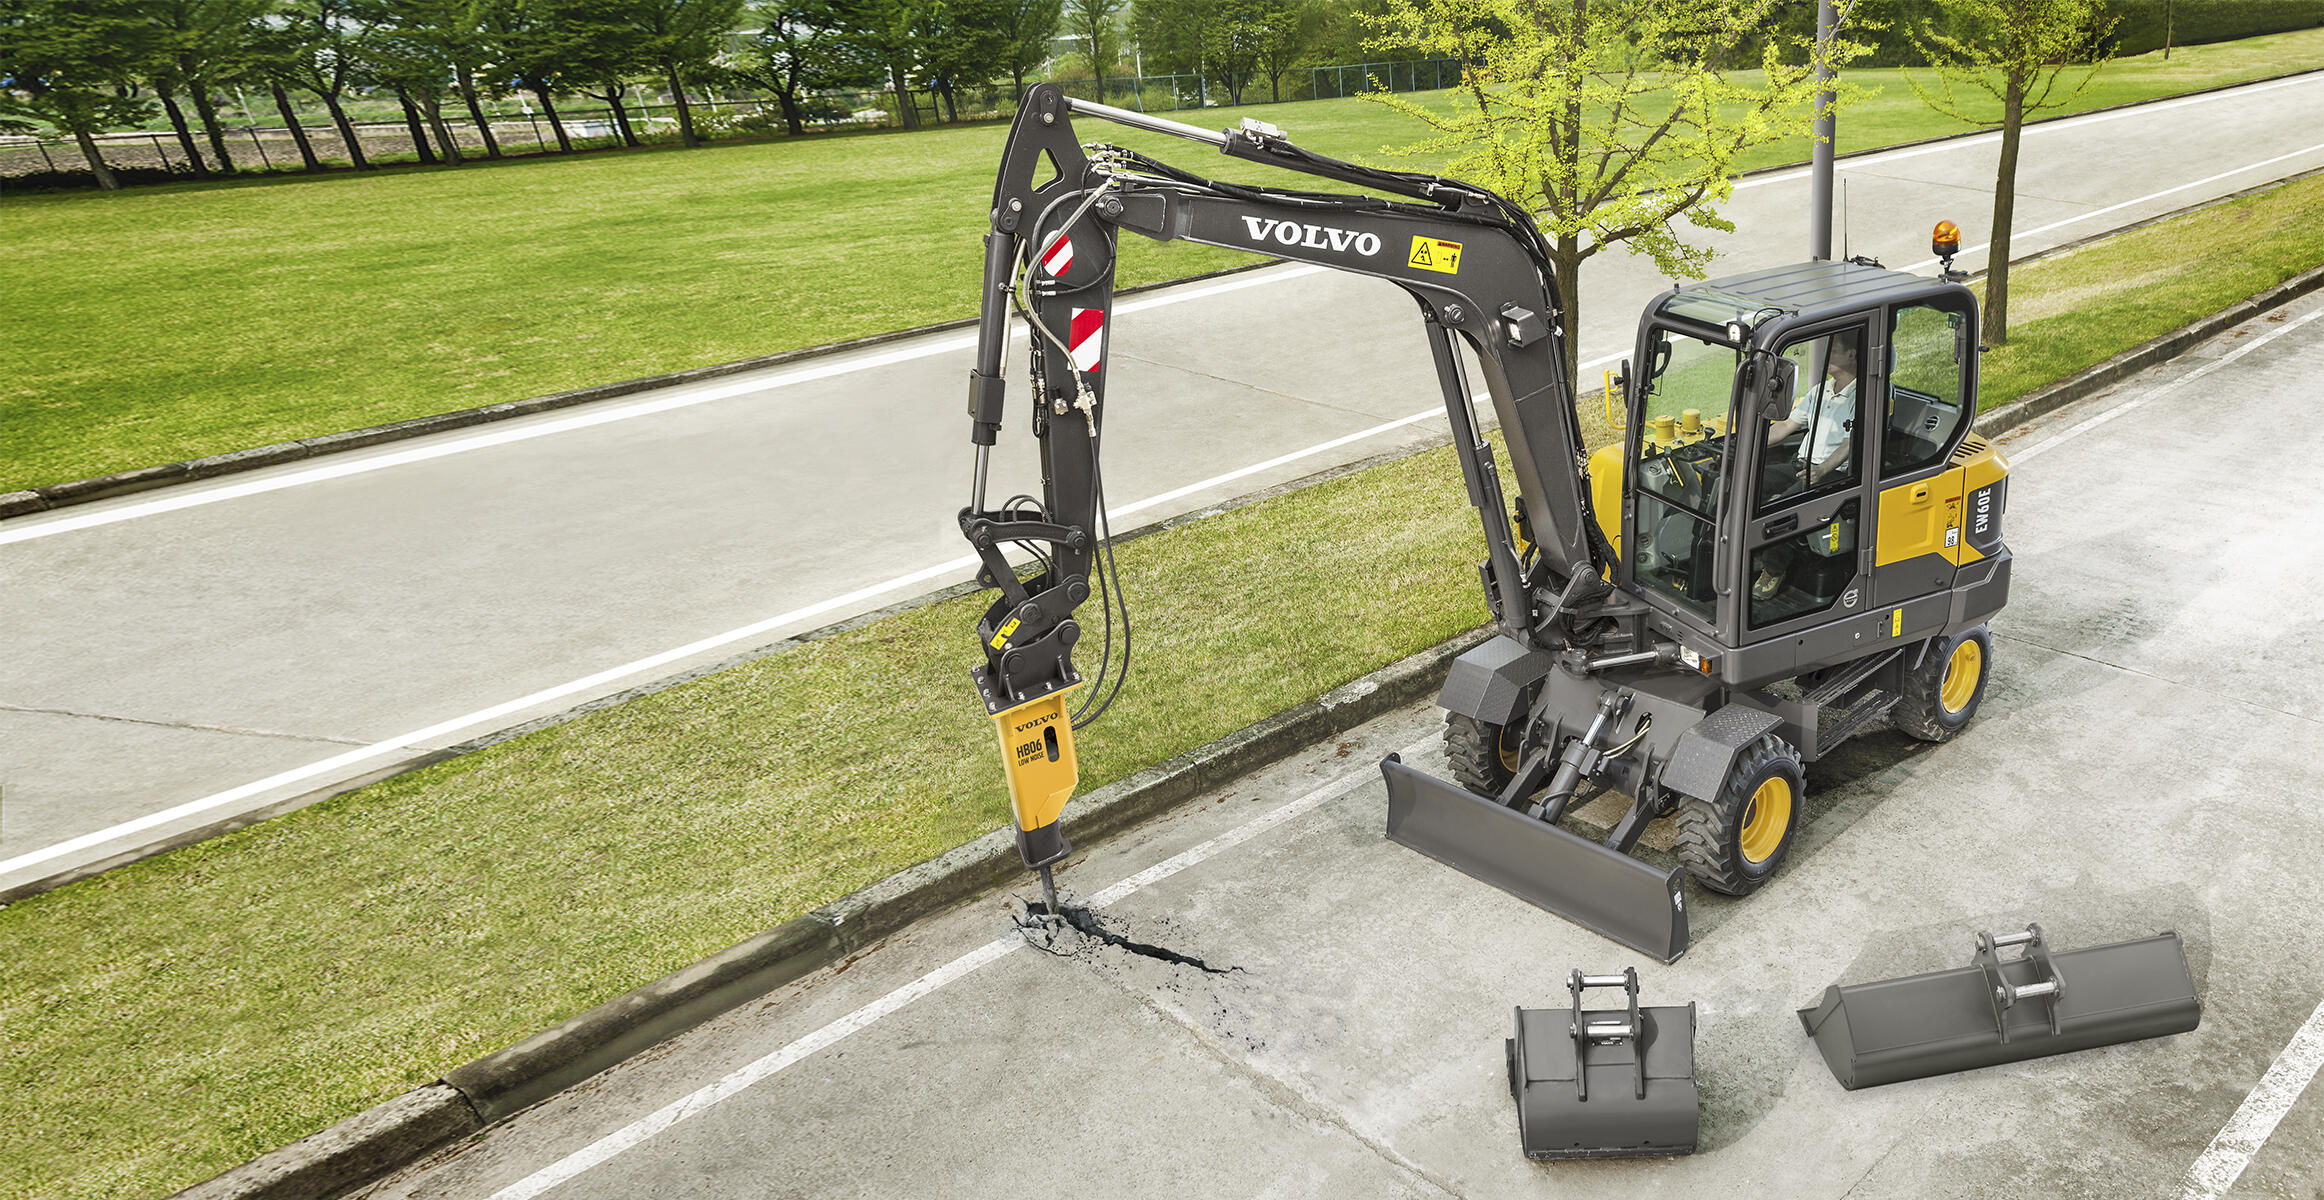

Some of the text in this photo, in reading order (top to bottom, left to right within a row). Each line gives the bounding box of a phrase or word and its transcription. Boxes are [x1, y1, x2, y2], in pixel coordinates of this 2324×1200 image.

[1241, 215, 1382, 256] VOLVO
[1975, 488, 1991, 534] EW60E
[1016, 712, 1058, 732] VOLVO
[1016, 739, 1042, 758] HB06
[1018, 751, 1044, 767] LOW NOISE
